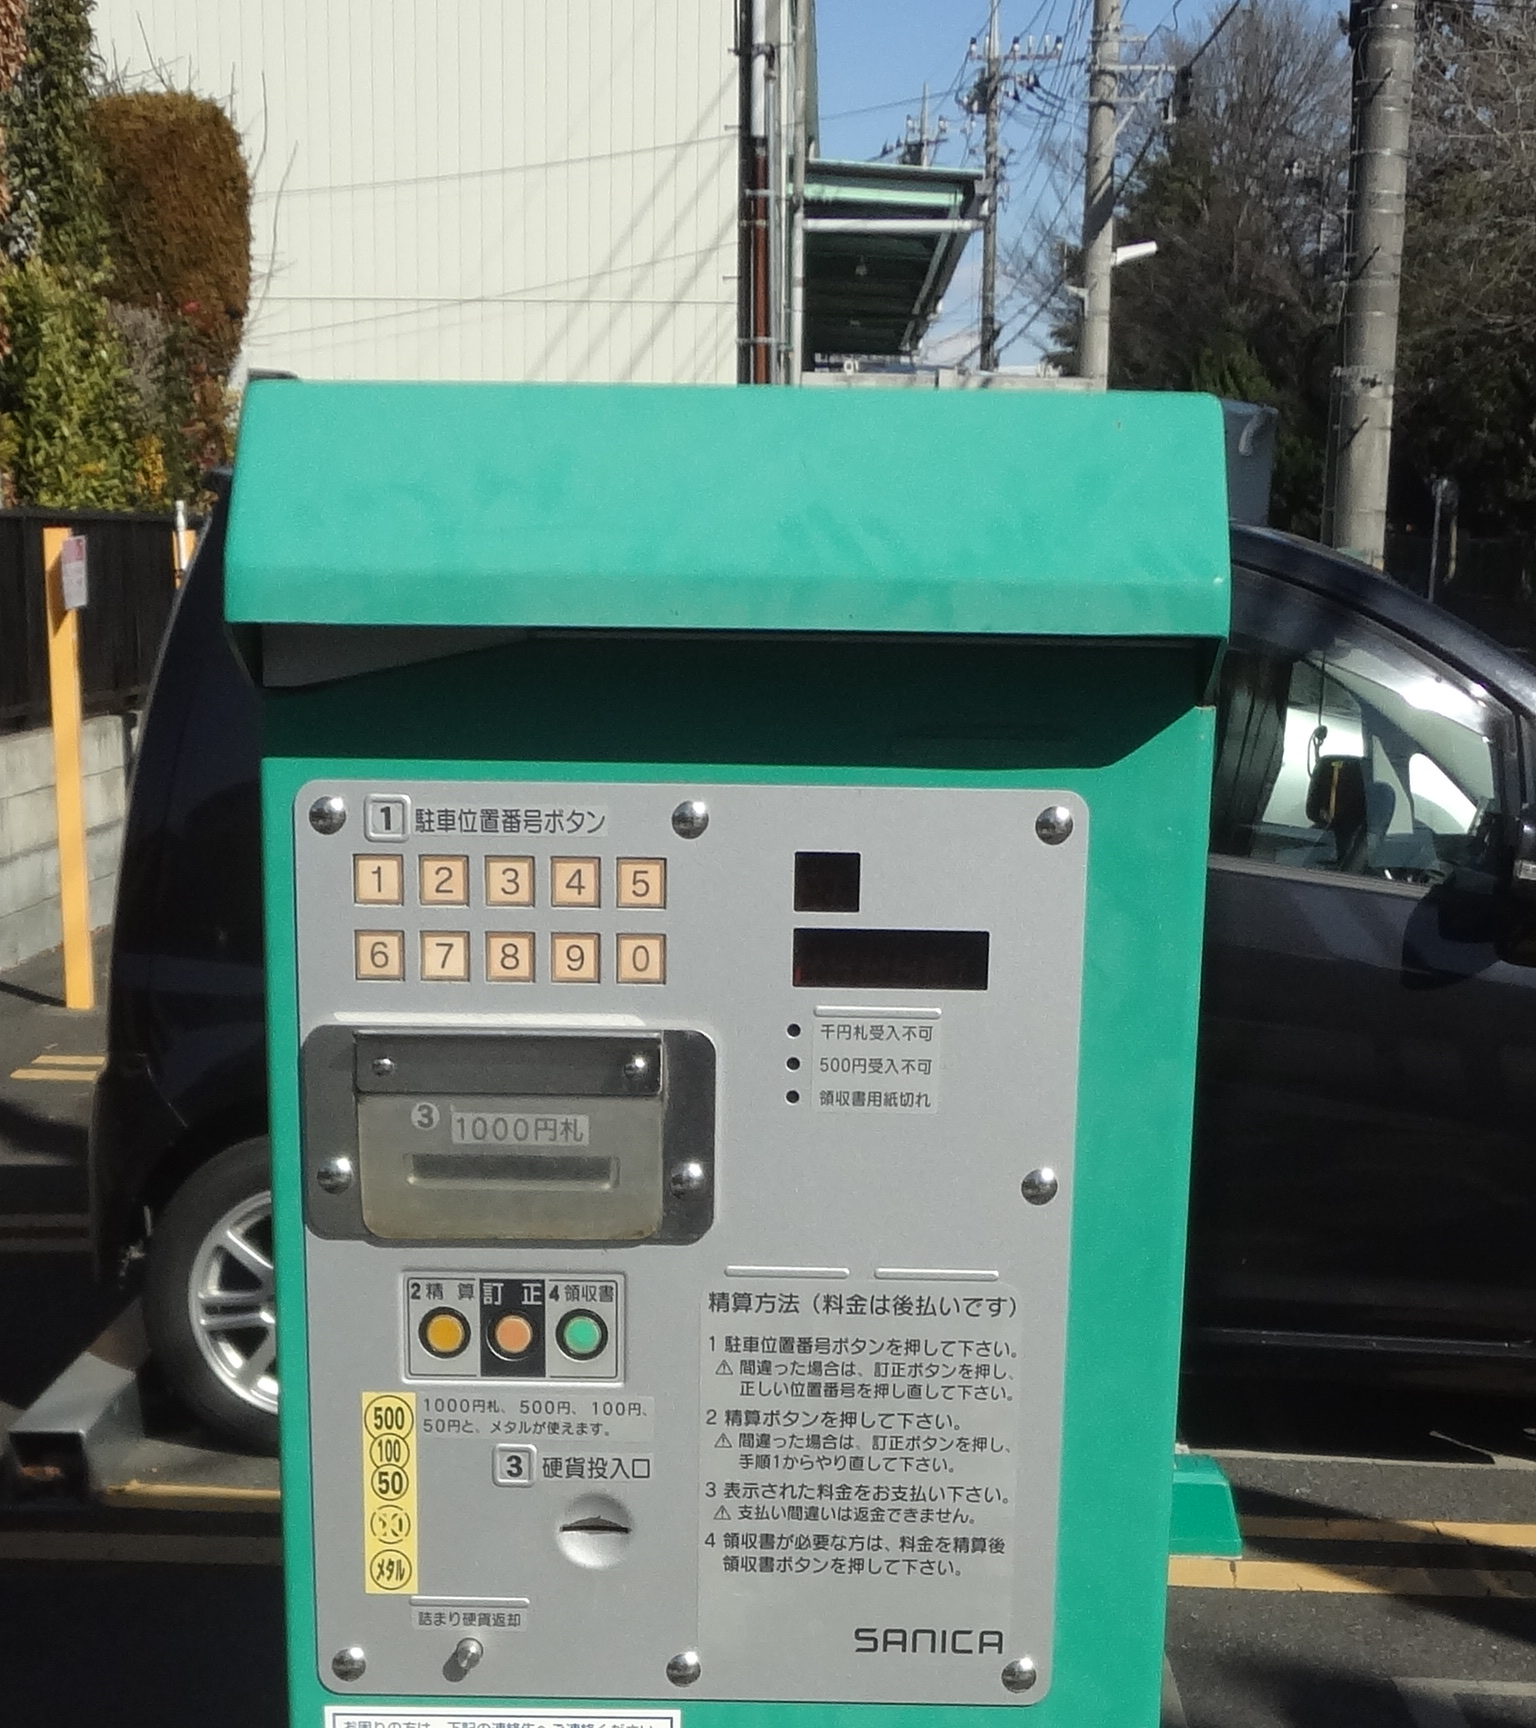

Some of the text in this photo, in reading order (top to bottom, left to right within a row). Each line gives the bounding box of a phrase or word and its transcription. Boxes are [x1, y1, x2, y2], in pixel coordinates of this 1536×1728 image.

[379, 805, 606, 834] 1 駐車位置番号ボタン
[371, 866, 382, 893] 1
[434, 866, 454, 894] 2
[500, 868, 520, 895] 3
[565, 869, 586, 896] 4
[631, 870, 650, 897] 5
[370, 941, 389, 968] 6
[435, 943, 454, 969] 7
[500, 943, 520, 970] 8
[566, 944, 585, 972] 9
[632, 945, 650, 972] 0
[820, 1023, 934, 1042] 千円札受入不可
[819, 1056, 933, 1075] 500円受入不可
[819, 1089, 931, 1108] 領収書用紙切れ
[457, 1116, 584, 1142] 1000円札
[410, 1282, 475, 1302] 2 精算
[482, 1282, 543, 1305] 訂正
[549, 1284, 615, 1304] 4 領収書
[724, 1335, 1018, 1359] 駐車位置番号ボタンを押して下さい。
[739, 1359, 1015, 1381] 間違った場合は、訂正ボタンを押し、
[739, 1380, 1014, 1402] 正しい位置番号を押し直して下さい。
[373, 1406, 405, 1431] 500
[706, 1409, 962, 1432] 2 精算ボタンを押して下さい。
[377, 1439, 401, 1463] 100
[738, 1432, 1011, 1454] 間違った場合は、訂正ボタンを押し、
[505, 1455, 651, 1480] 3 硬貨投入口
[738, 1454, 955, 1474] 手順1からやり直して下さい。
[377, 1471, 404, 1495] 50
[705, 1481, 1010, 1504] 3 表示された料金をお支払い下さい。
[737, 1504, 976, 1525] 支払い間違いは返金できません。
[704, 1532, 1006, 1555] 4 領収書が必要な方は、料金を精算後
[376, 1558, 405, 1582] メタル
[722, 1555, 962, 1577] 領収書ボタンを押して下さい。
[418, 1611, 521, 1628] 詰まり硬貨返却
[854, 1627, 1004, 1655] SANICA
